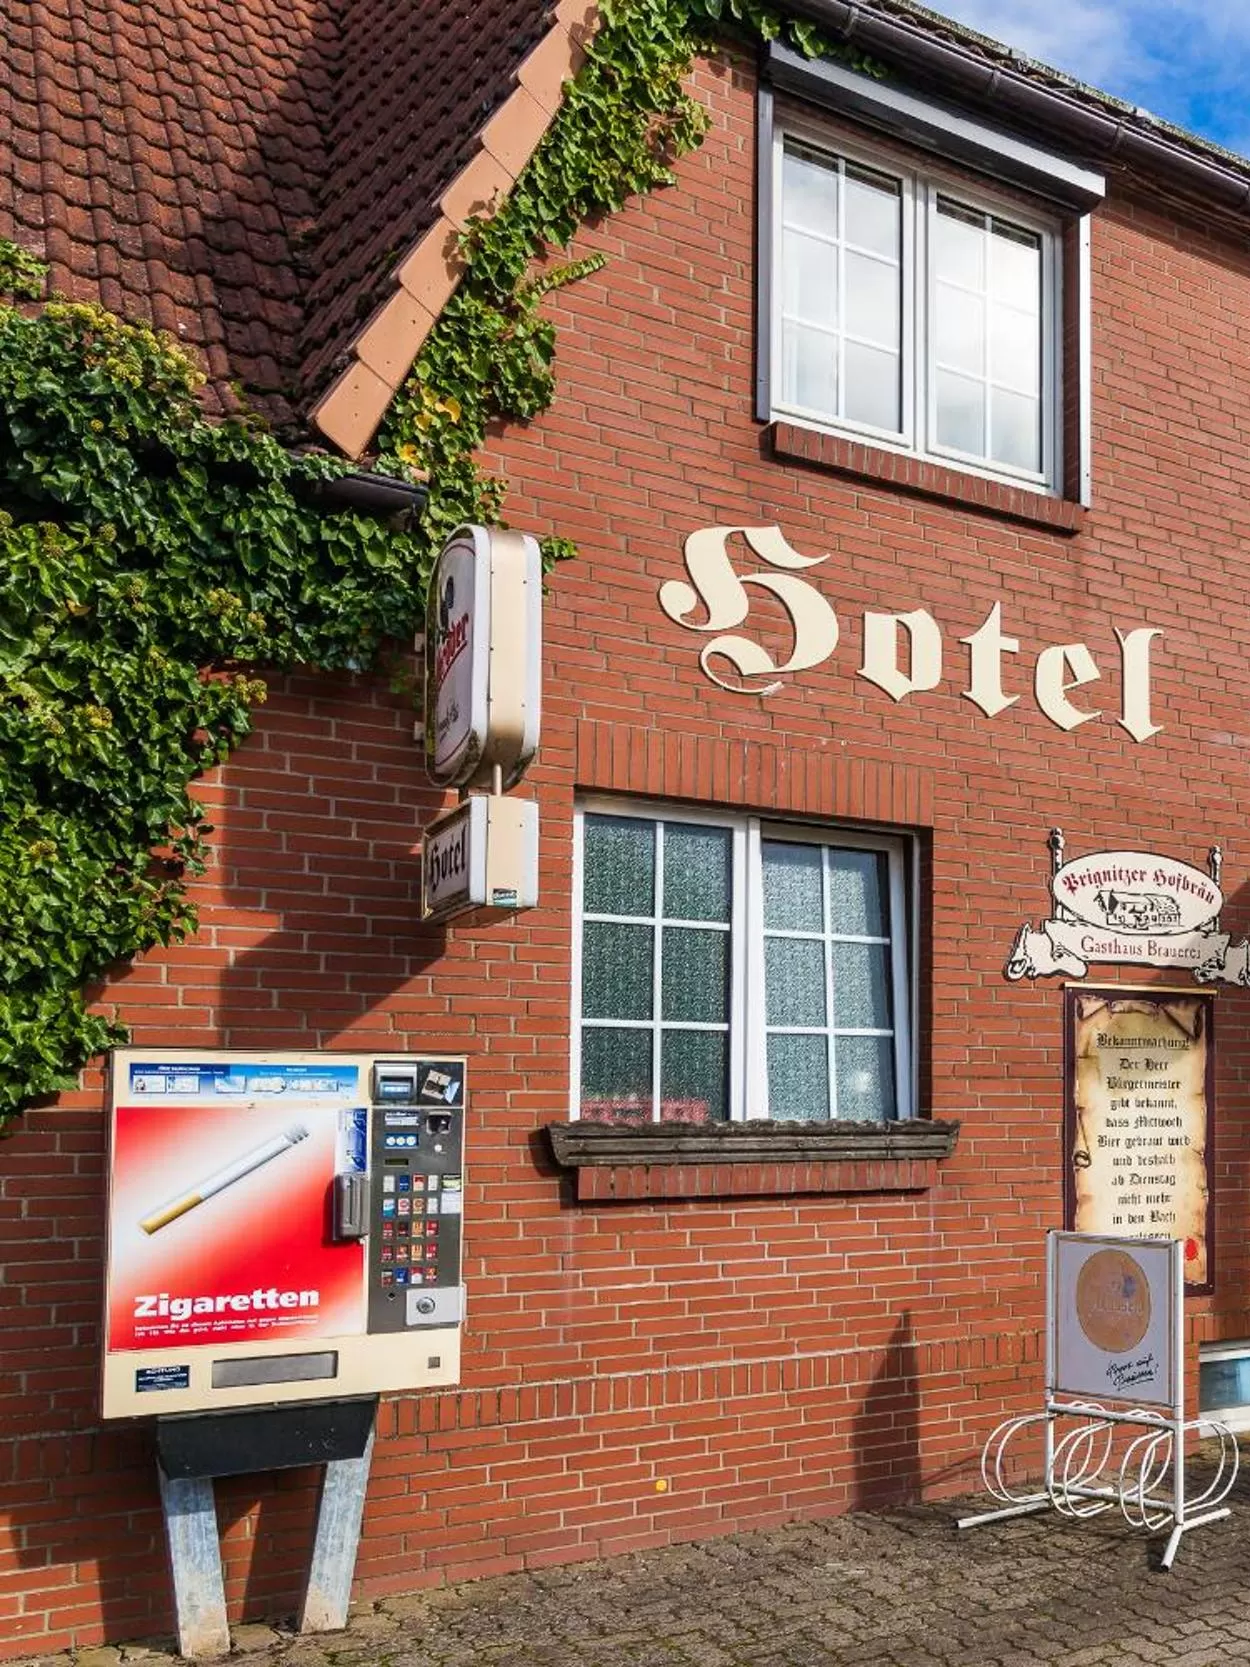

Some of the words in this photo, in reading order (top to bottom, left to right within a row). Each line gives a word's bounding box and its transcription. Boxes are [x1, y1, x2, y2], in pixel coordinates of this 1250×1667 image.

[658, 524, 1164, 744] Hotel
[430, 823, 467, 893] Hotel
[1062, 864, 1147, 896] Prignitzer
[1153, 867, 1216, 906] Hofbräu
[1081, 936, 1143, 957] Gasthaus
[1147, 939, 1202, 960] Brauerei
[134, 1288, 320, 1321] Zigaretten
